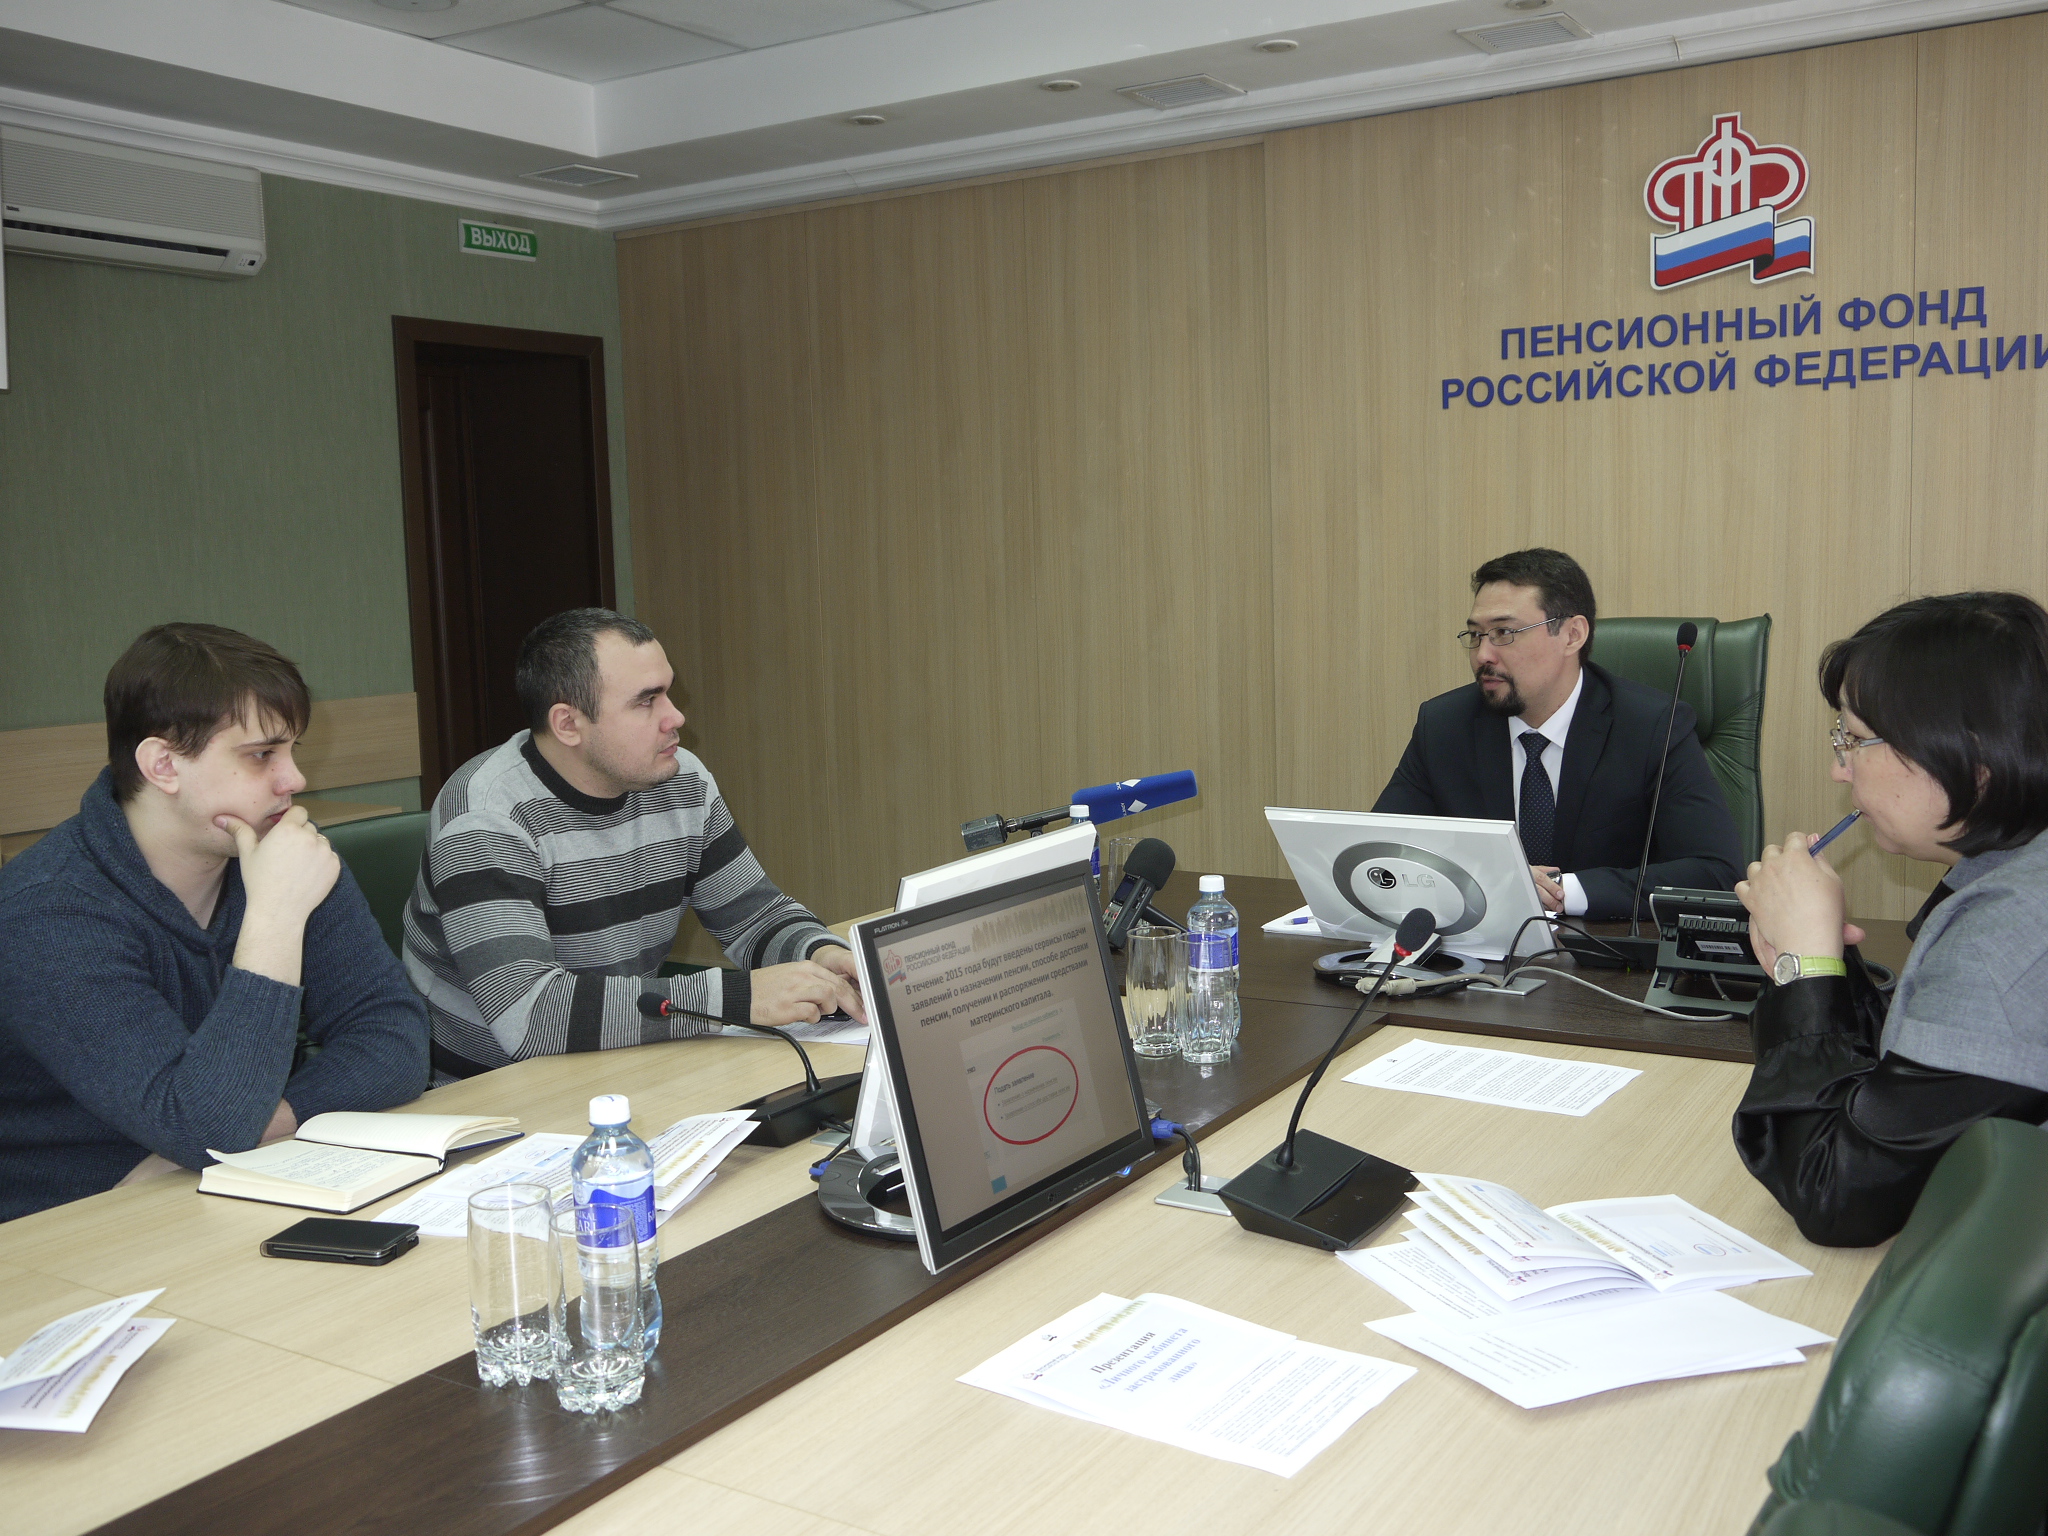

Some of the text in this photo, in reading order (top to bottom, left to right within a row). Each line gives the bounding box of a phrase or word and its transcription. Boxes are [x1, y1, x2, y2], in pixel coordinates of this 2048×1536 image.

[470, 226, 531, 254] ВЫХОД
[1500, 286, 1987, 360] ПЕНСИОННЫЙ ФОНД
[1441, 350, 1736, 409] РОССИЙСКОЙ
[1401, 873, 1436, 888] LG
[904, 941, 957, 962] ПЕНСИОННЫЙ ФОНД
[905, 926, 1086, 995] В течение 2015 года будут введены сервисы подачи
[911, 942, 1089, 1012] заявлений о назначении пенсии, способе доставки
[920, 959, 1089, 1027] пенсии, получении и распоряжении средствами
[970, 1001, 1020, 1027] материнского
[1020, 990, 1054, 1008] капитала.
[1090, 1331, 1156, 1374] Презентация
[1124, 1338, 1201, 1392] застрахованного
[1144, 1327, 1188, 1360] кабинета
